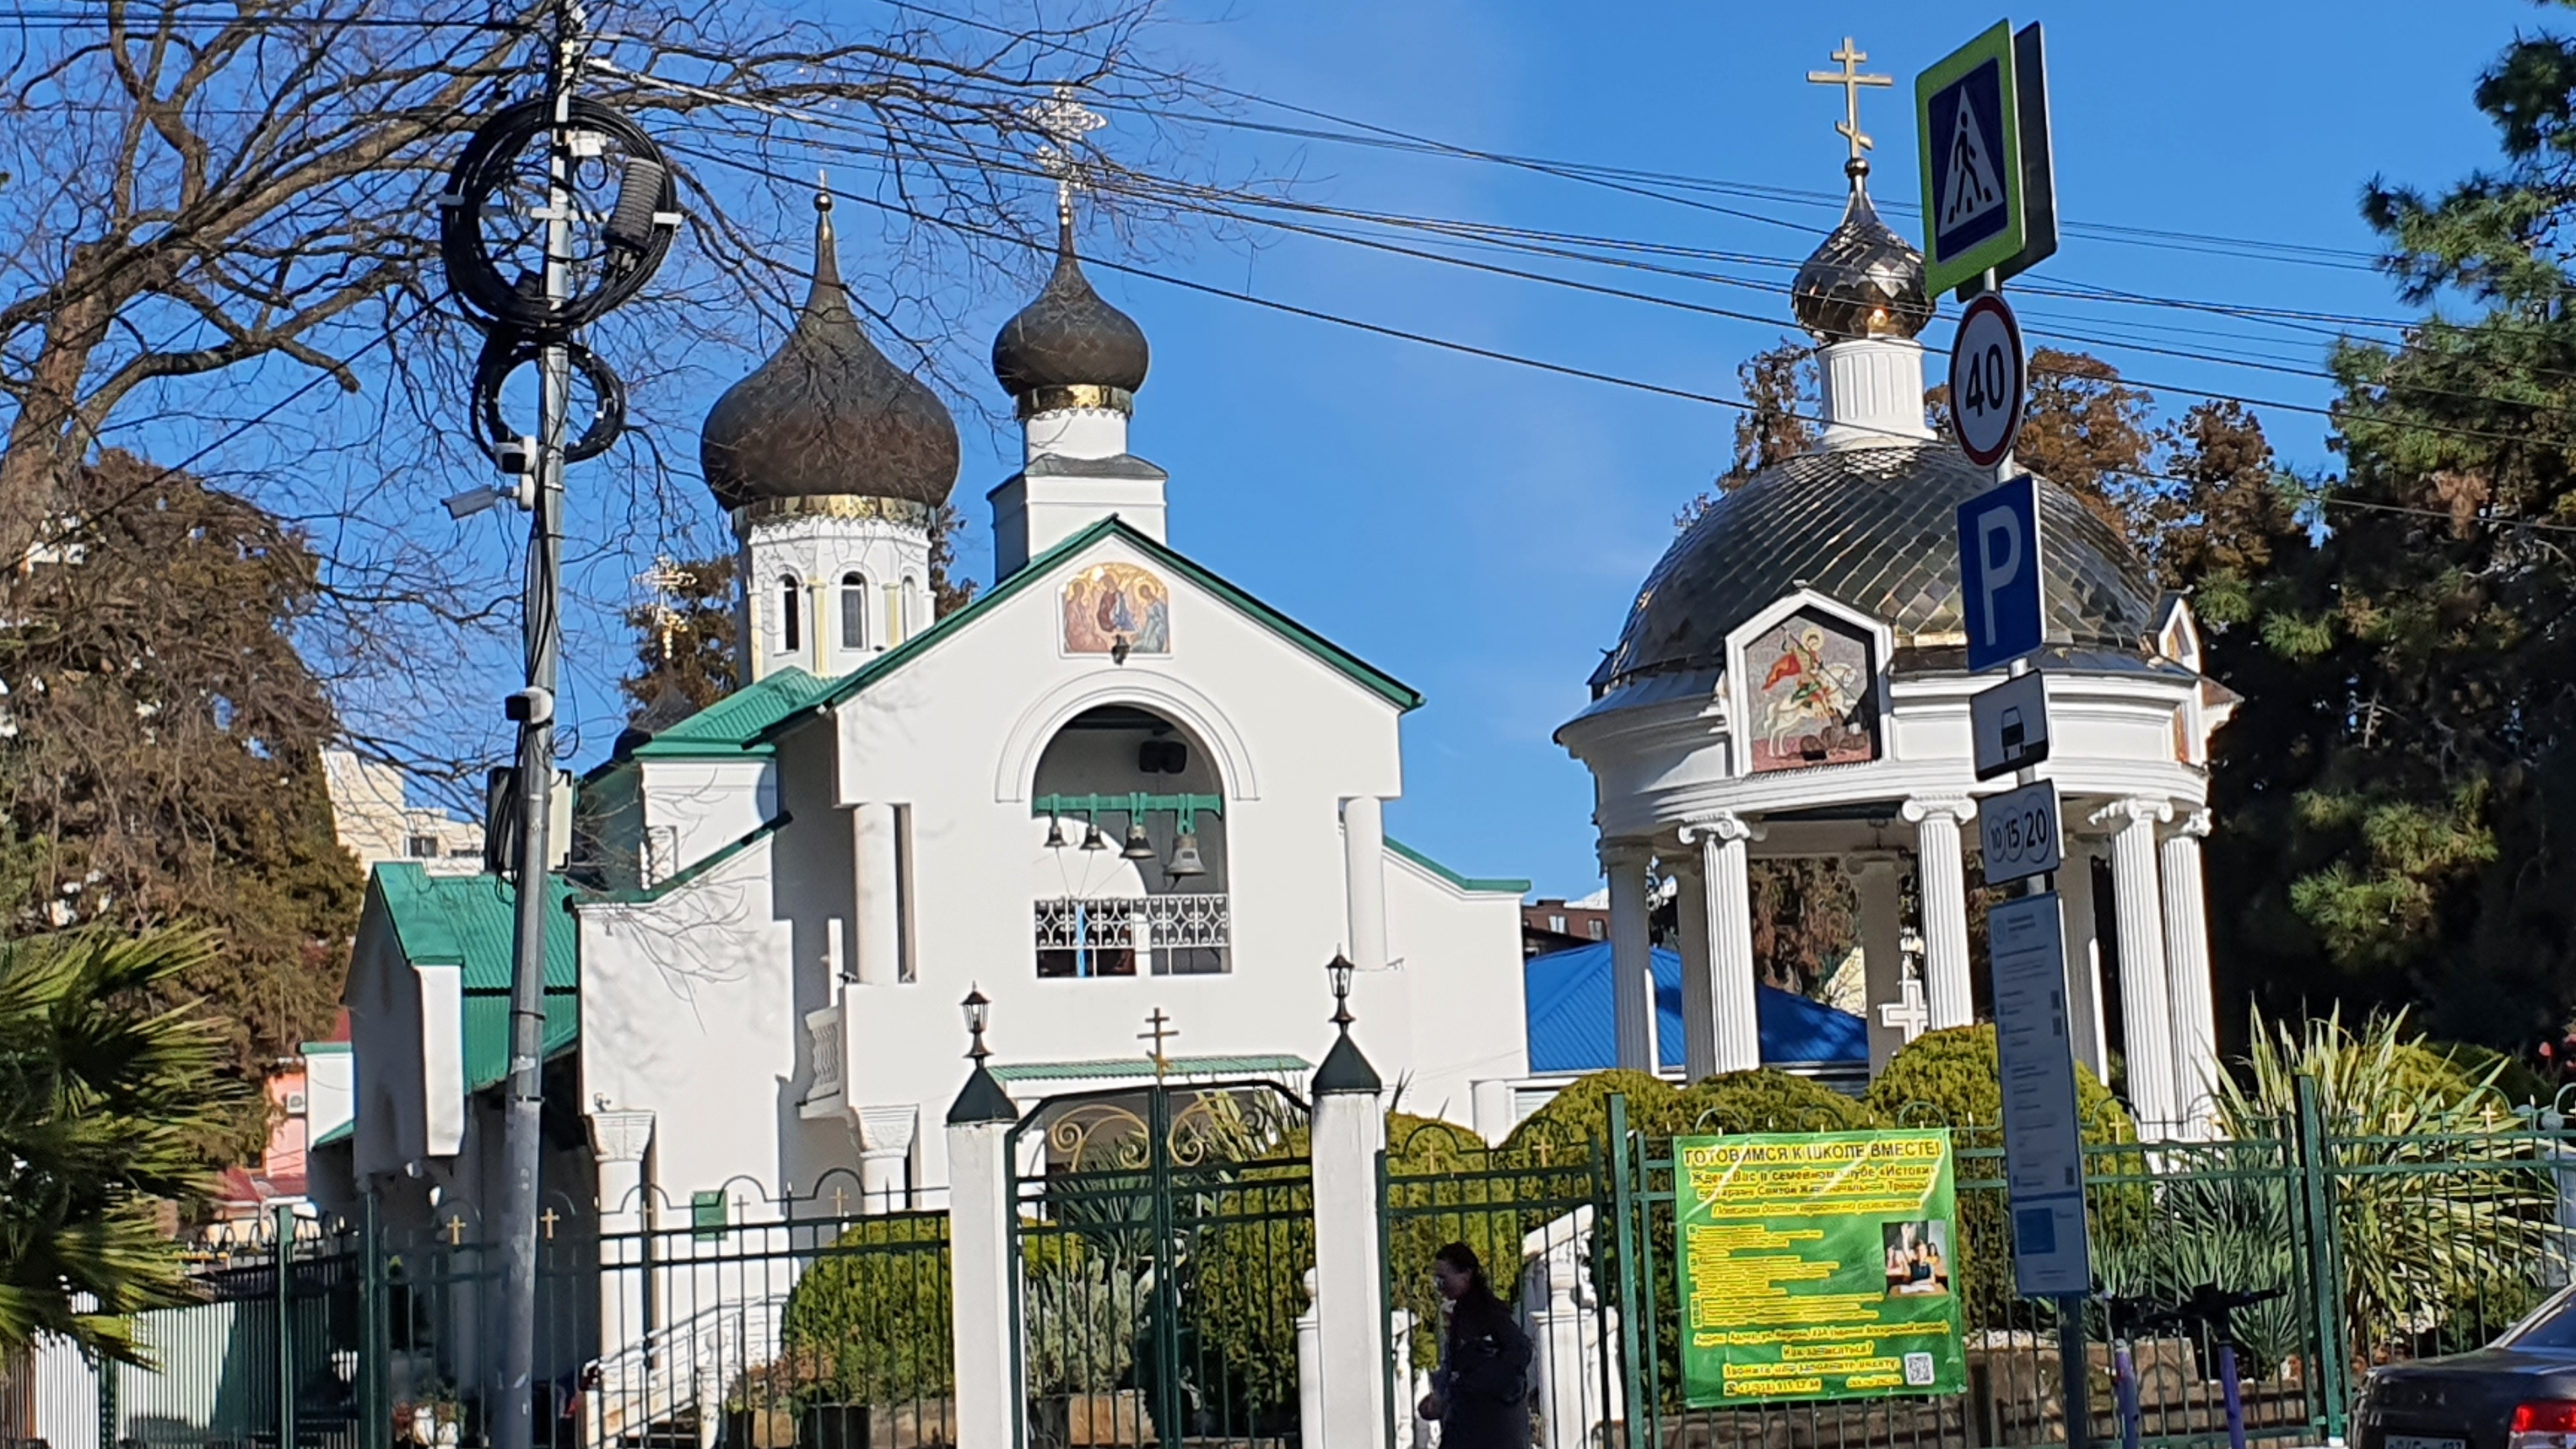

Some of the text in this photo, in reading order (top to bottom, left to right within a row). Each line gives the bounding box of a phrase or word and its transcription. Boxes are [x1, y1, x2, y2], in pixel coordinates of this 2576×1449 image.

[1965, 343, 2006, 417] 40
[1978, 505, 2022, 646] P
[1990, 808, 2047, 851] 10 15 20
[1685, 1140, 1941, 1164] ГОТОВИМСЯ К ШКОЛЕ ВМЕСТЕ!
